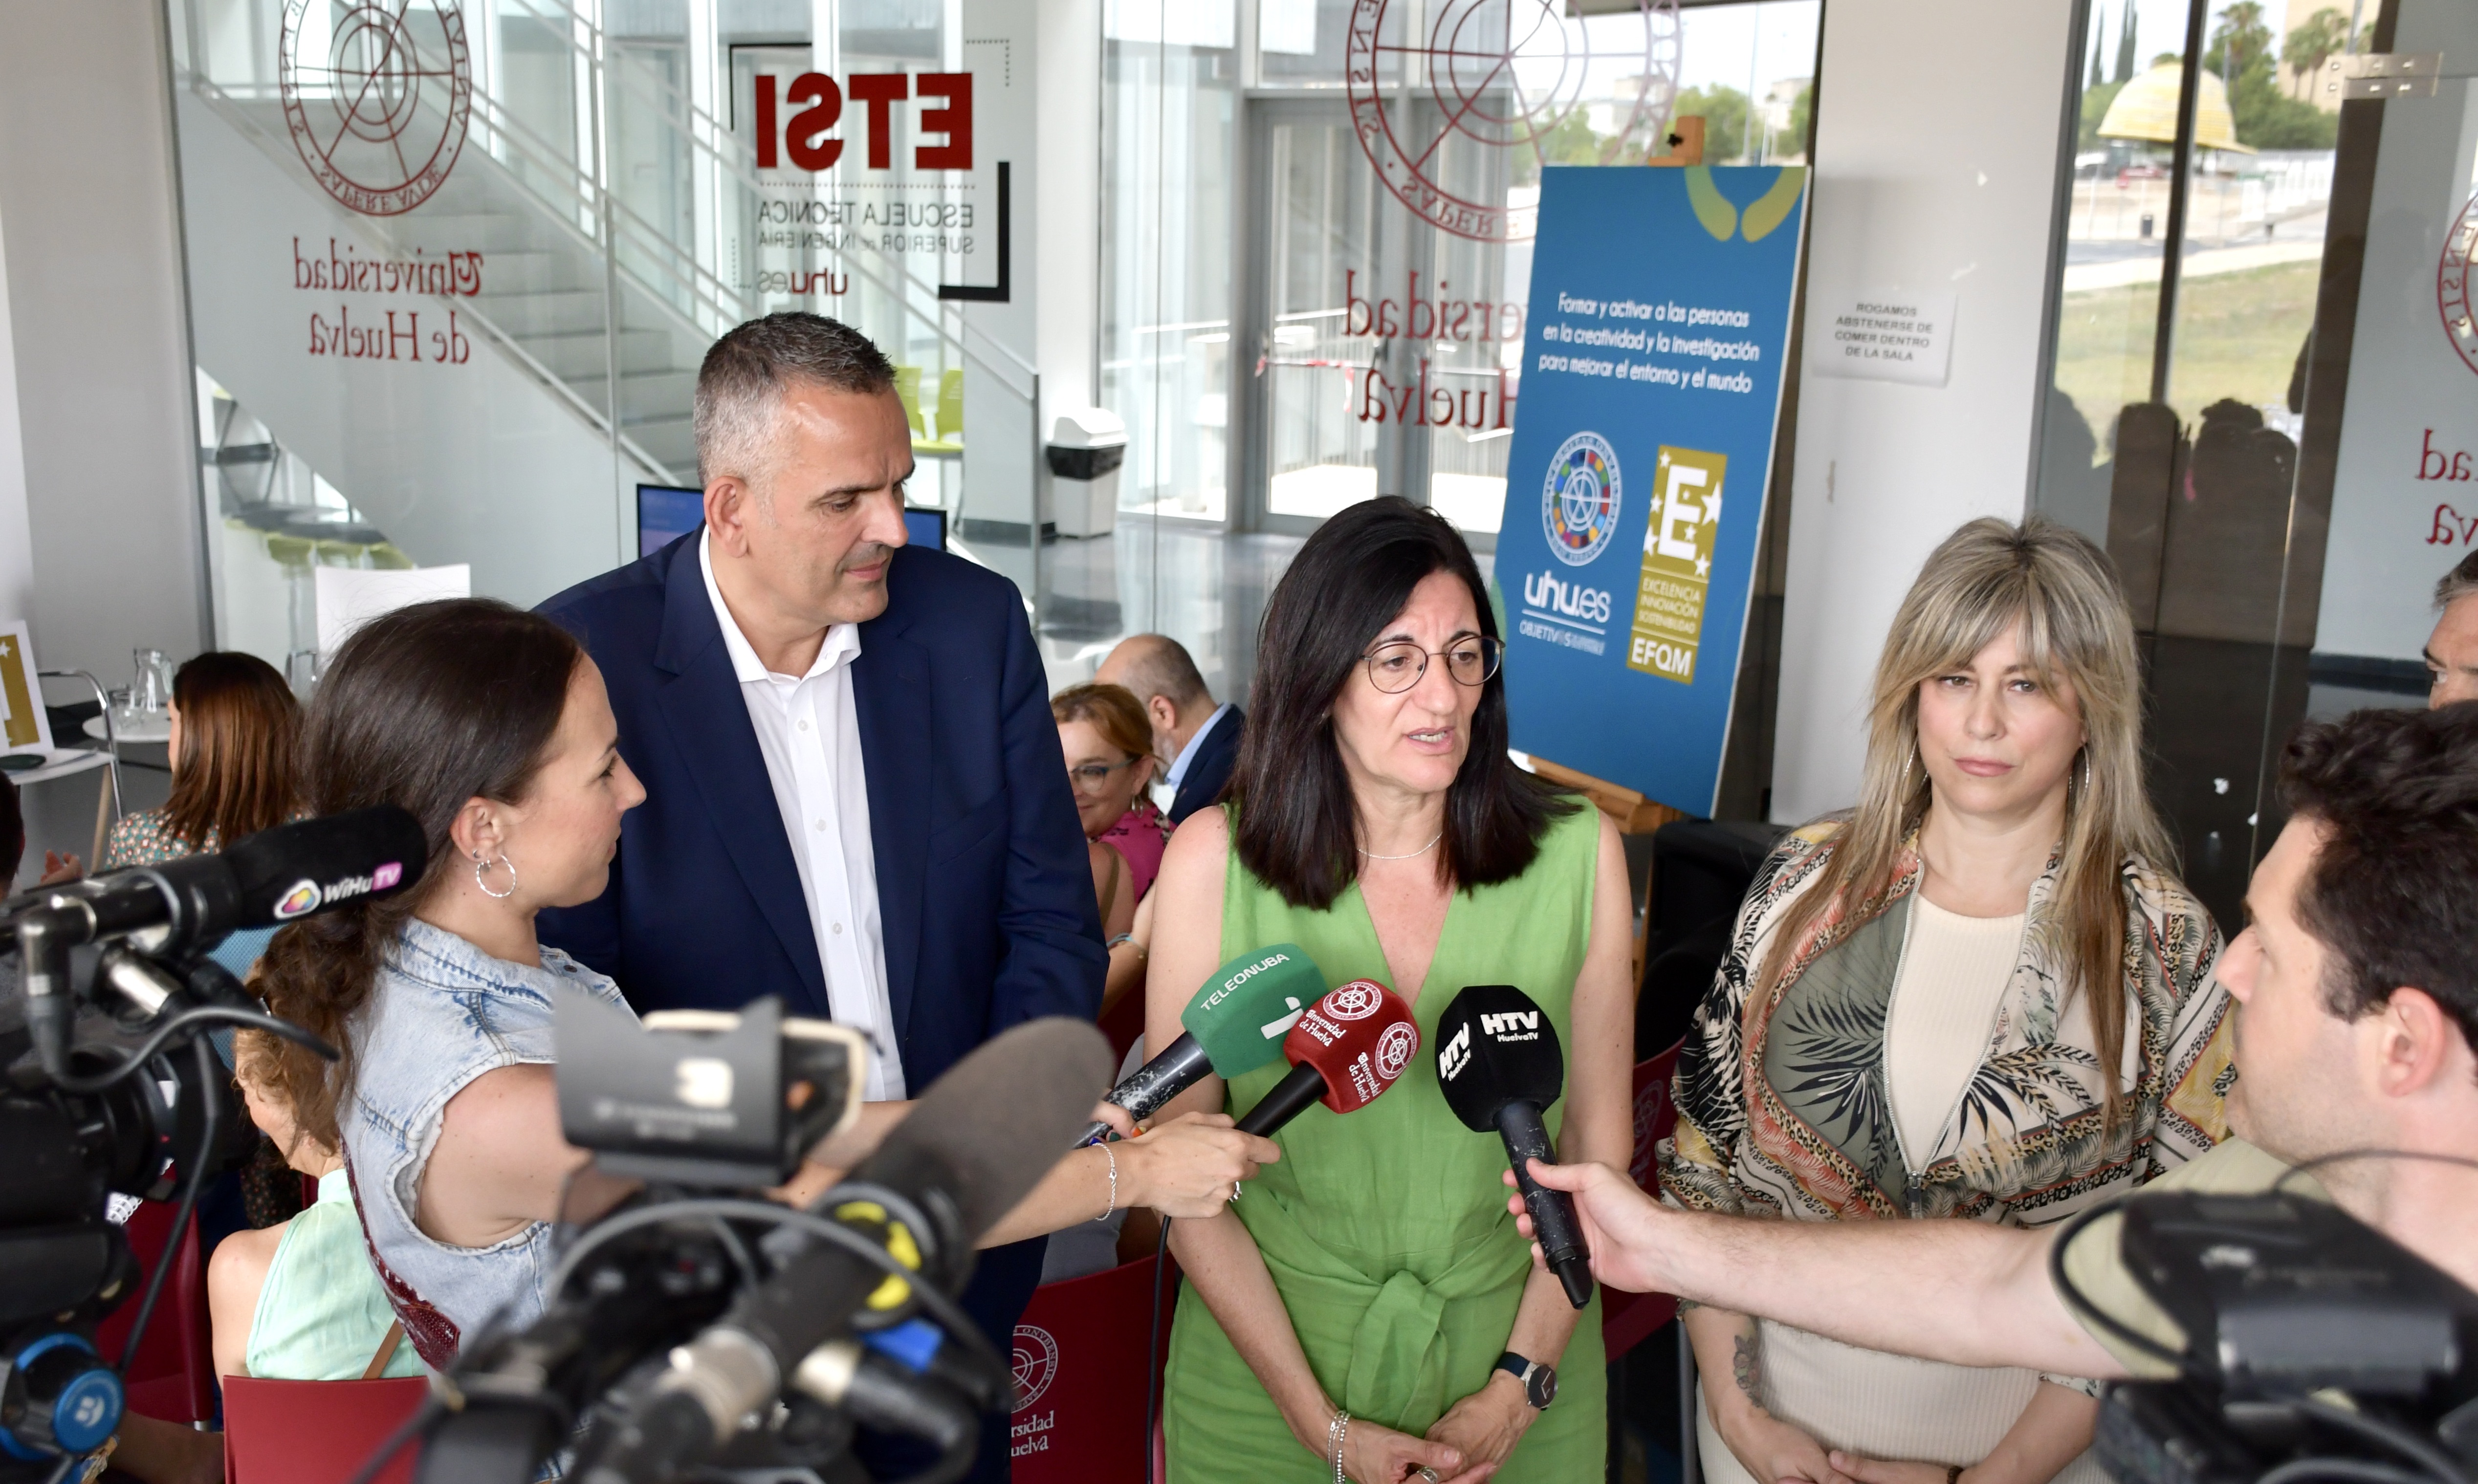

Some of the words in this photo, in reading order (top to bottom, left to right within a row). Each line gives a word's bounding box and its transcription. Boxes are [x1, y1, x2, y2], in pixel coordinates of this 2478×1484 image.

[1557, 291, 1598, 313] Formar
[1599, 300, 1608, 319] y
[1609, 300, 1652, 320] activar
[1655, 304, 1665, 321] a
[1667, 301, 1686, 323] las
[1688, 306, 1750, 328] personas
[1856, 302, 1917, 317] ROGAMOS
[1836, 316, 1913, 333] ABSTENERSE
[1917, 321, 1933, 334] DE
[1543, 324, 1558, 342] en
[1559, 322, 1572, 343] la
[1574, 326, 1645, 351] creatividad
[1645, 336, 1655, 355] y
[1656, 331, 1669, 353] la
[1671, 335, 1760, 362] investigación
[1835, 330, 1877, 343] COMER
[1880, 334, 1930, 349] DENTRO
[1845, 346, 1862, 357] DE
[1864, 349, 1879, 359] LA
[1882, 349, 1913, 362] SALA
[1538, 352, 1569, 372] para
[1569, 357, 1614, 377] mejorar
[1615, 357, 1627, 379] el
[1629, 363, 1679, 386] entorno
[1680, 371, 1689, 391] y
[1691, 366, 1705, 389] el
[1707, 370, 1753, 394] mundo
[1642, 577, 1701, 603] EXCELENCIA
[1640, 594, 1699, 619] INNOVACIÓN
[1631, 636, 1692, 677] EFQM
[1200, 953, 1291, 1011] TELEONUBA
[1299, 1019, 1309, 1030] de
[1306, 1023, 1333, 1047] Huelva
[1305, 1009, 1347, 1039] Universidad
[1480, 1010, 1538, 1035] HTV
[1438, 1022, 1470, 1079] HTV
[1496, 1032, 1539, 1043] HuelvaTV
[1349, 1064, 1361, 1077] de
[1447, 1048, 1472, 1082] HuelvaTV
[1353, 1072, 1371, 1103] Huelva
[1011, 1434, 1049, 1457] uelva
